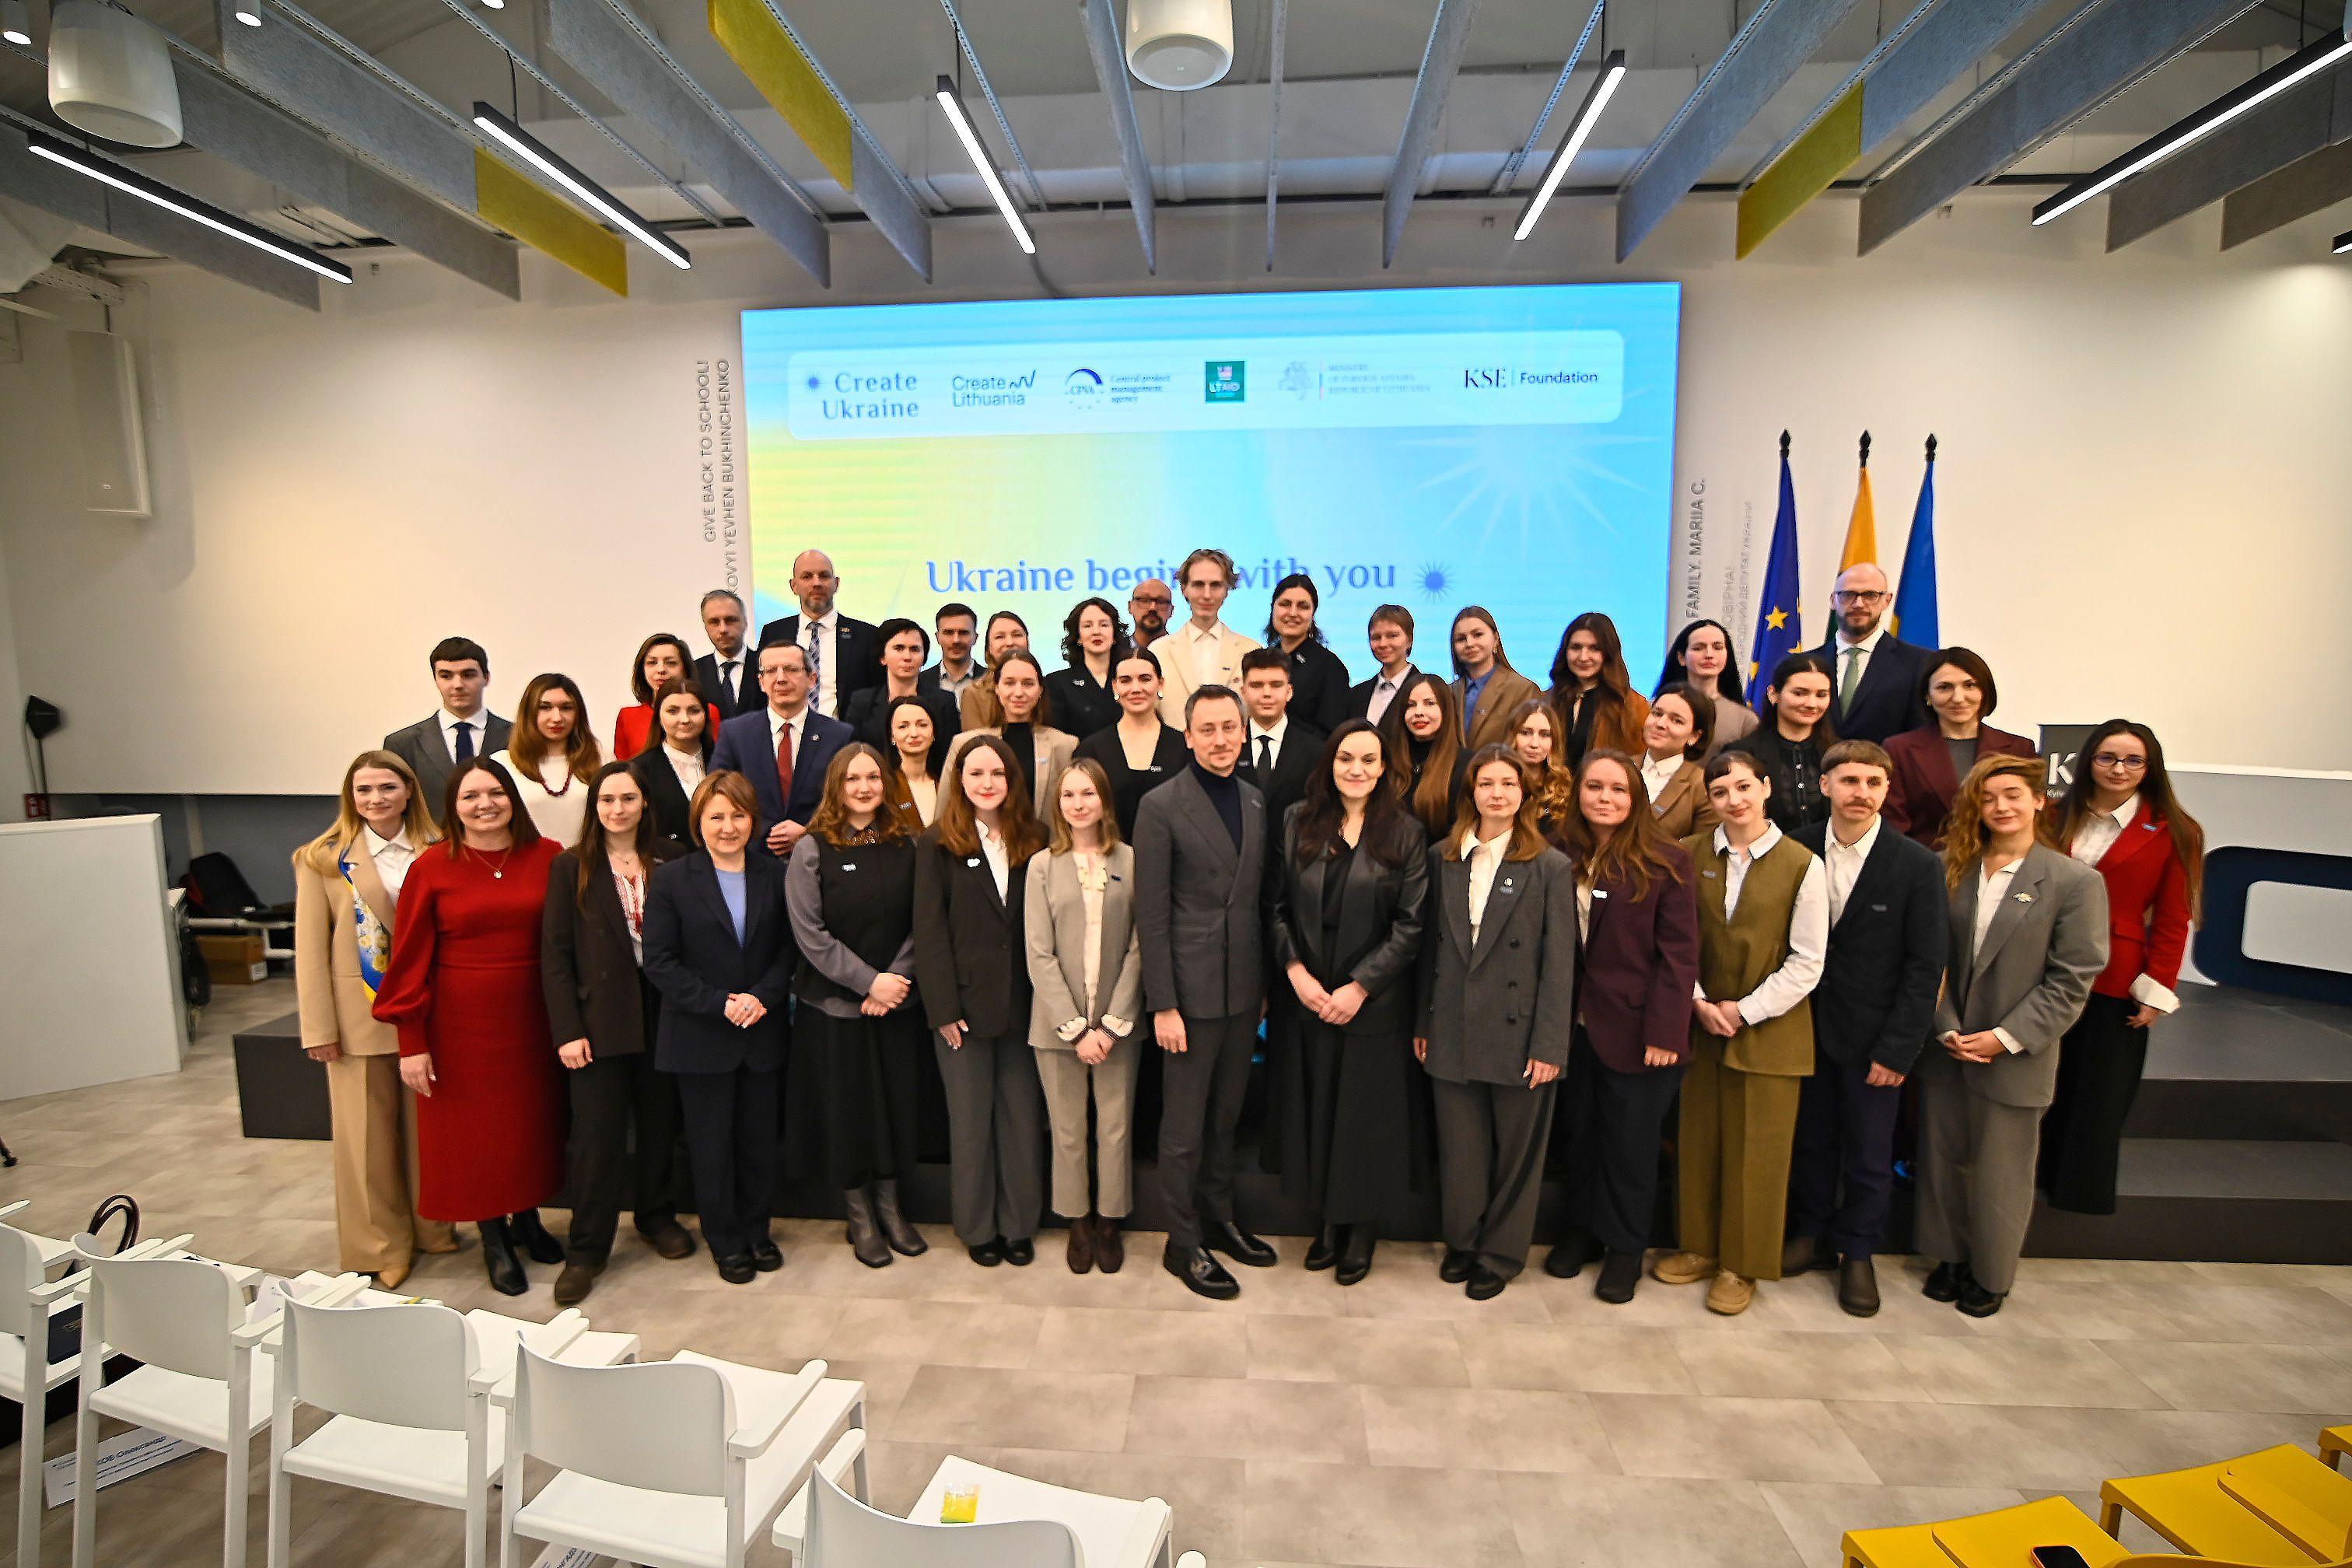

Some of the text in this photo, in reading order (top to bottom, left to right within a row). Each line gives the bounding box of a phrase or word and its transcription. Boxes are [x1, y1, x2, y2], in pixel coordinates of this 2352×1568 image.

[835, 373, 918, 393] Create
[953, 376, 1006, 390] Create
[1465, 368, 1598, 388] KSE Foundation
[822, 398, 919, 420] Ukraine
[953, 391, 1026, 408] Lithuania
[716, 359, 735, 483] BUKHINCHENKO
[697, 359, 716, 543] GIVE BACK TO SCHOOL!
[723, 488, 737, 547] YEVHEN
[1685, 478, 1706, 618] FAMILY. MARIIA C.
[926, 559, 1075, 593] Ukraine
[1324, 564, 1396, 598] you
